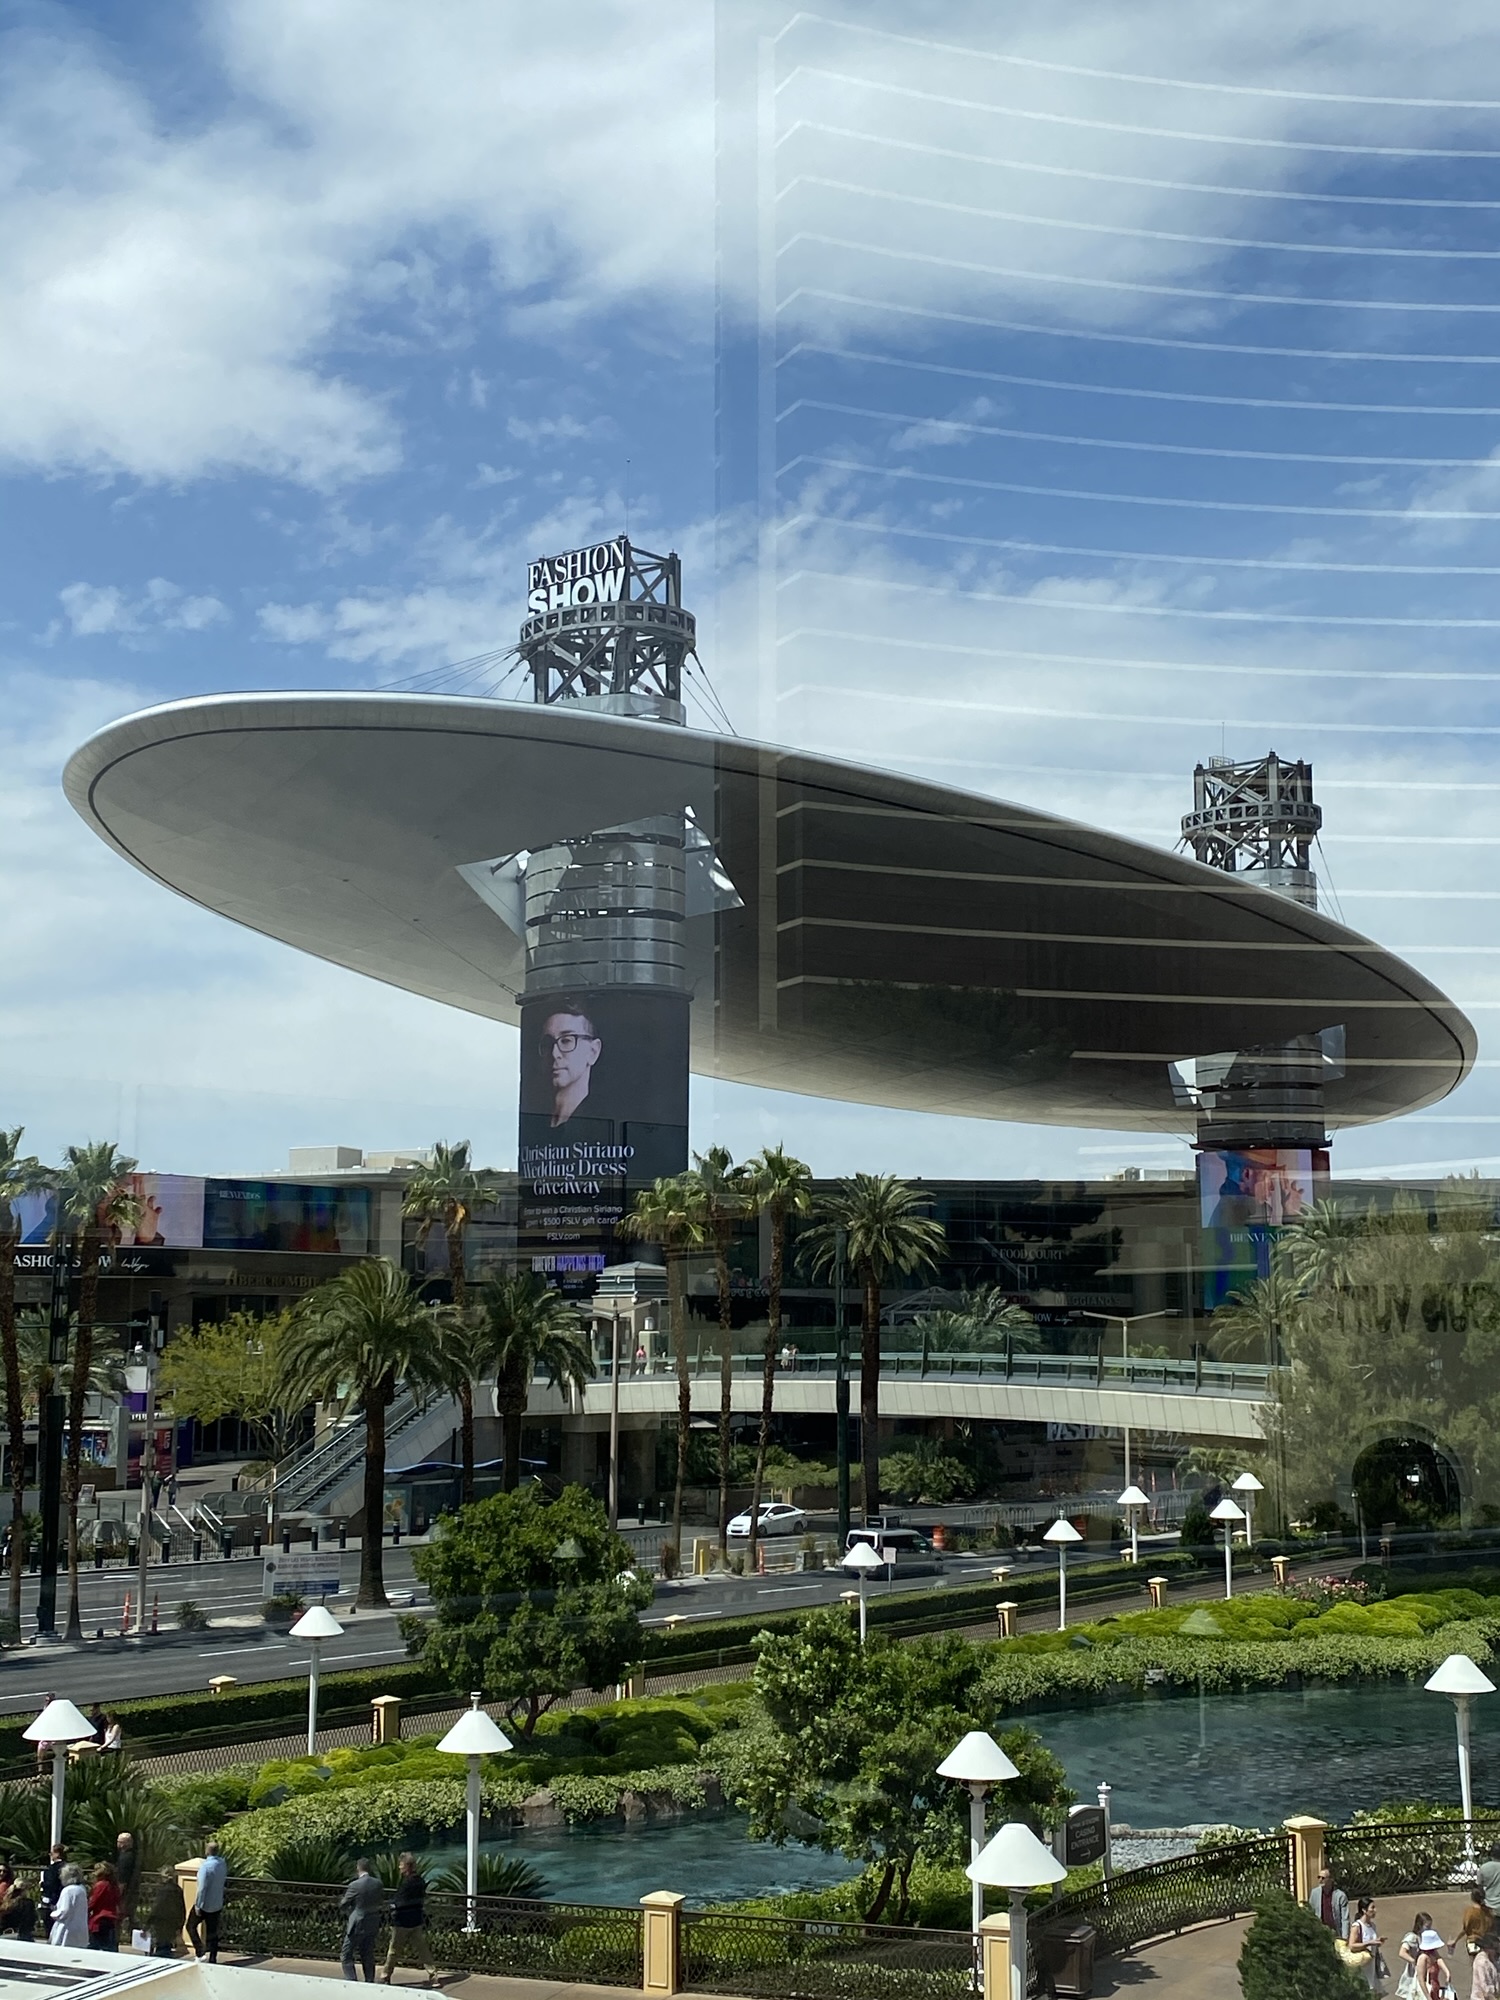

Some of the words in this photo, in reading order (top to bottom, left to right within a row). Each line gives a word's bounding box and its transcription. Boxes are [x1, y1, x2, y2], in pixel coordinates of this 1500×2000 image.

[528, 539, 626, 591] FASHION
[528, 566, 626, 618] SHOW
[521, 1143, 569, 1162] Christian
[572, 1141, 635, 1158] Siriano
[523, 1161, 576, 1181] Wedding
[578, 1159, 628, 1176] Dress
[533, 1179, 604, 1199] Giveaway
[542, 1207, 553, 1215] win
[560, 1205, 592, 1214] Christian
[594, 1205, 623, 1213] Siriano
[543, 1217, 561, 1226] $500
[562, 1217, 580, 1225] FSLV
[582, 1216, 595, 1227] gift
[547, 1232, 580, 1241] FSLV.com
[13, 1255, 67, 1268] ASHIO
[72, 1255, 112, 1268] SW
[999, 1248, 1028, 1260] FOOD
[1029, 1249, 1064, 1261] COURT
[1055, 1292, 1121, 1306] MGGIANO'S
[1033, 1312, 1052, 1323] HOW
[1075, 1825, 1096, 1839] CASINO
